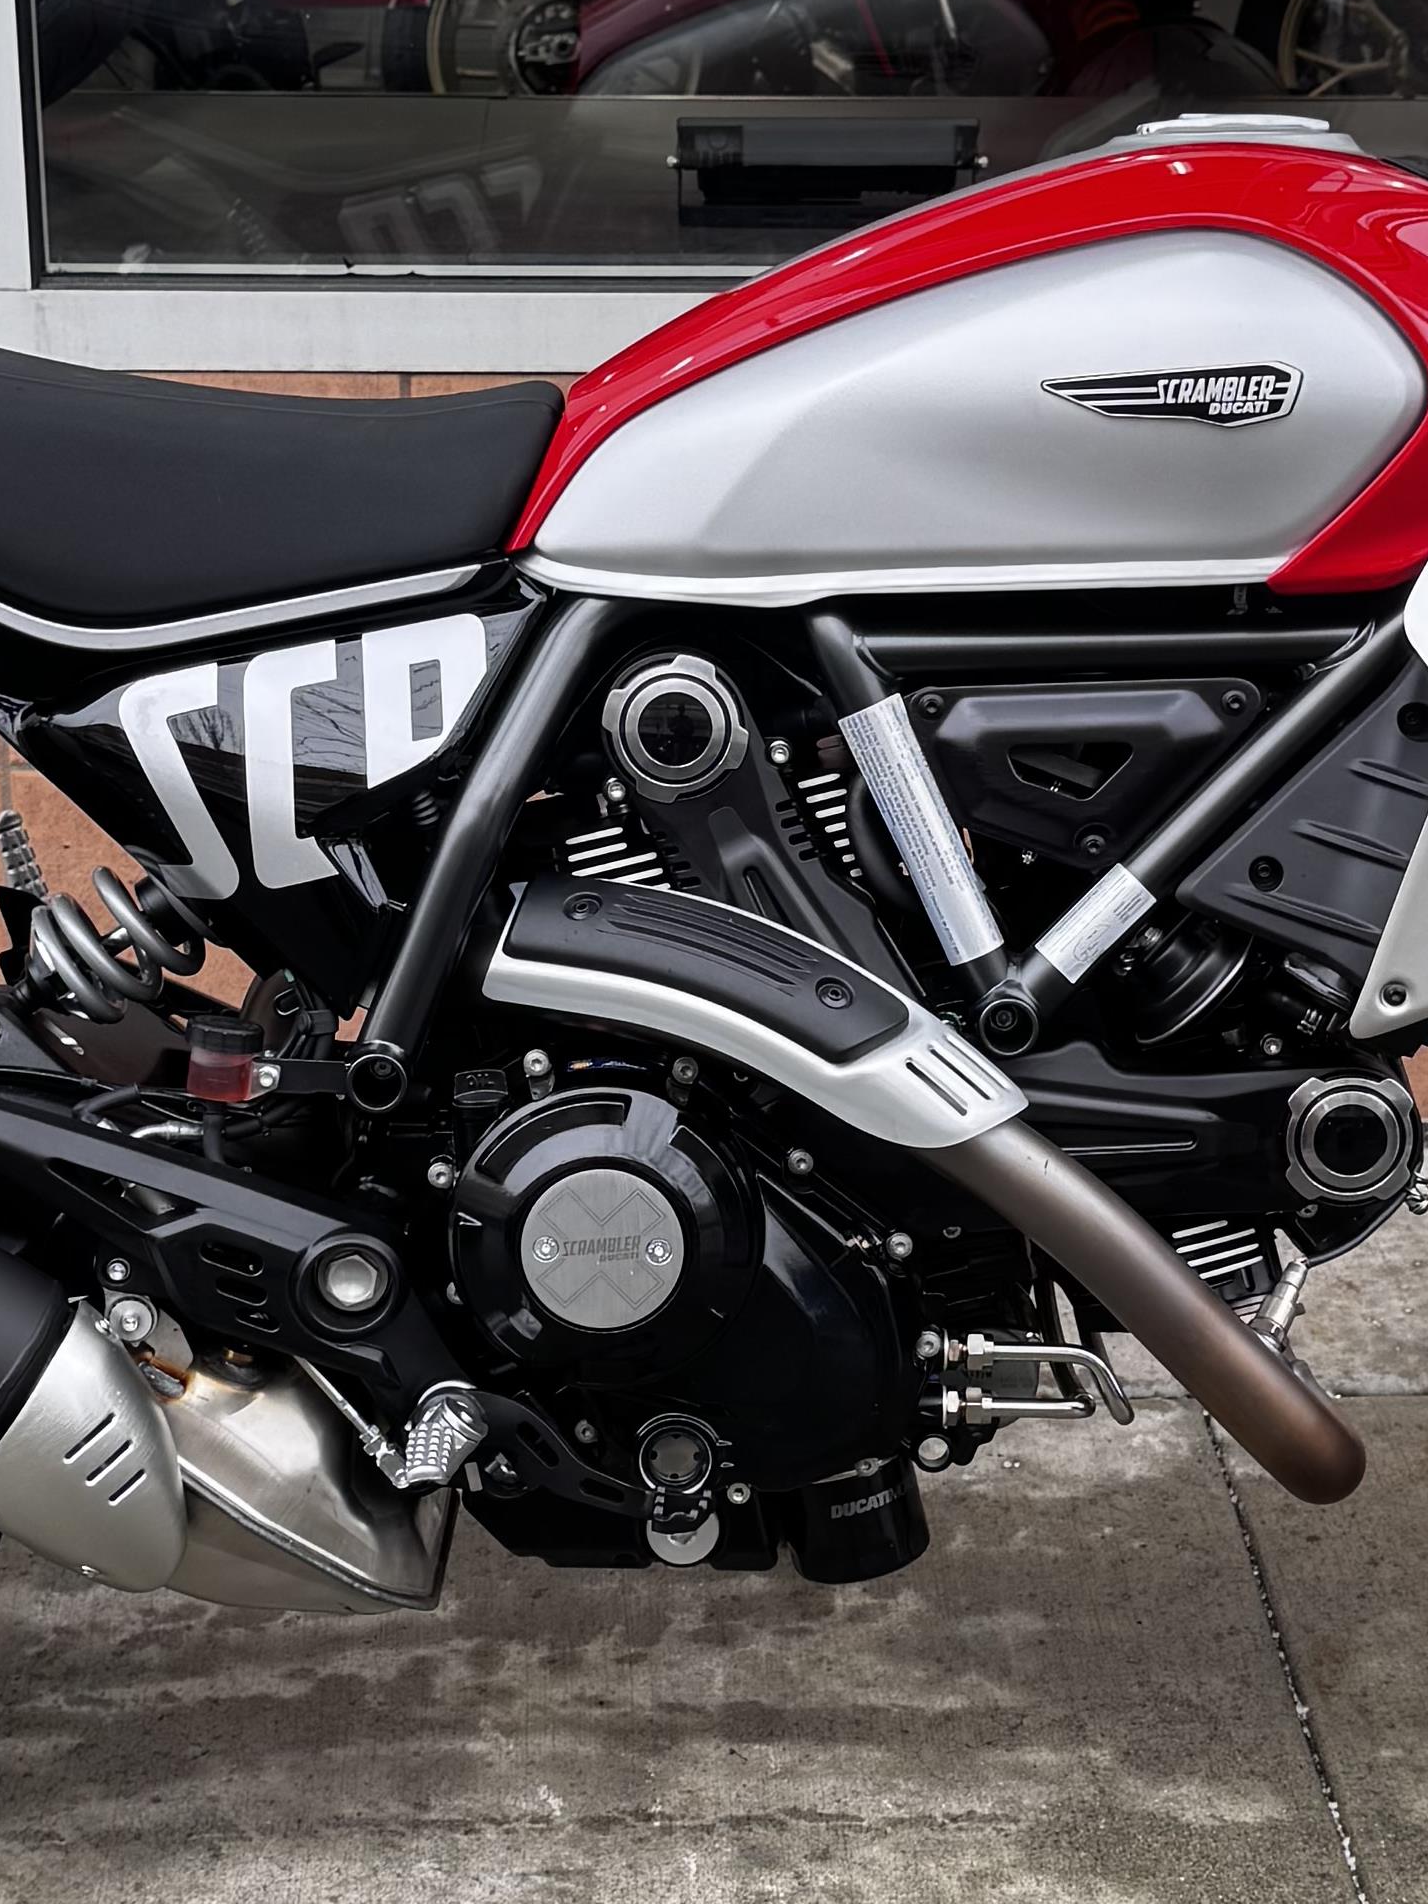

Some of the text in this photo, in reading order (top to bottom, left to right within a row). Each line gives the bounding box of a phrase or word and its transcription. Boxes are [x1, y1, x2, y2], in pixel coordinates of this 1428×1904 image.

[1157, 375, 1276, 405] SCRAMBLER
[1208, 400, 1270, 416] DUCATI
[561, 1234, 641, 1256] SCRAMBLER
